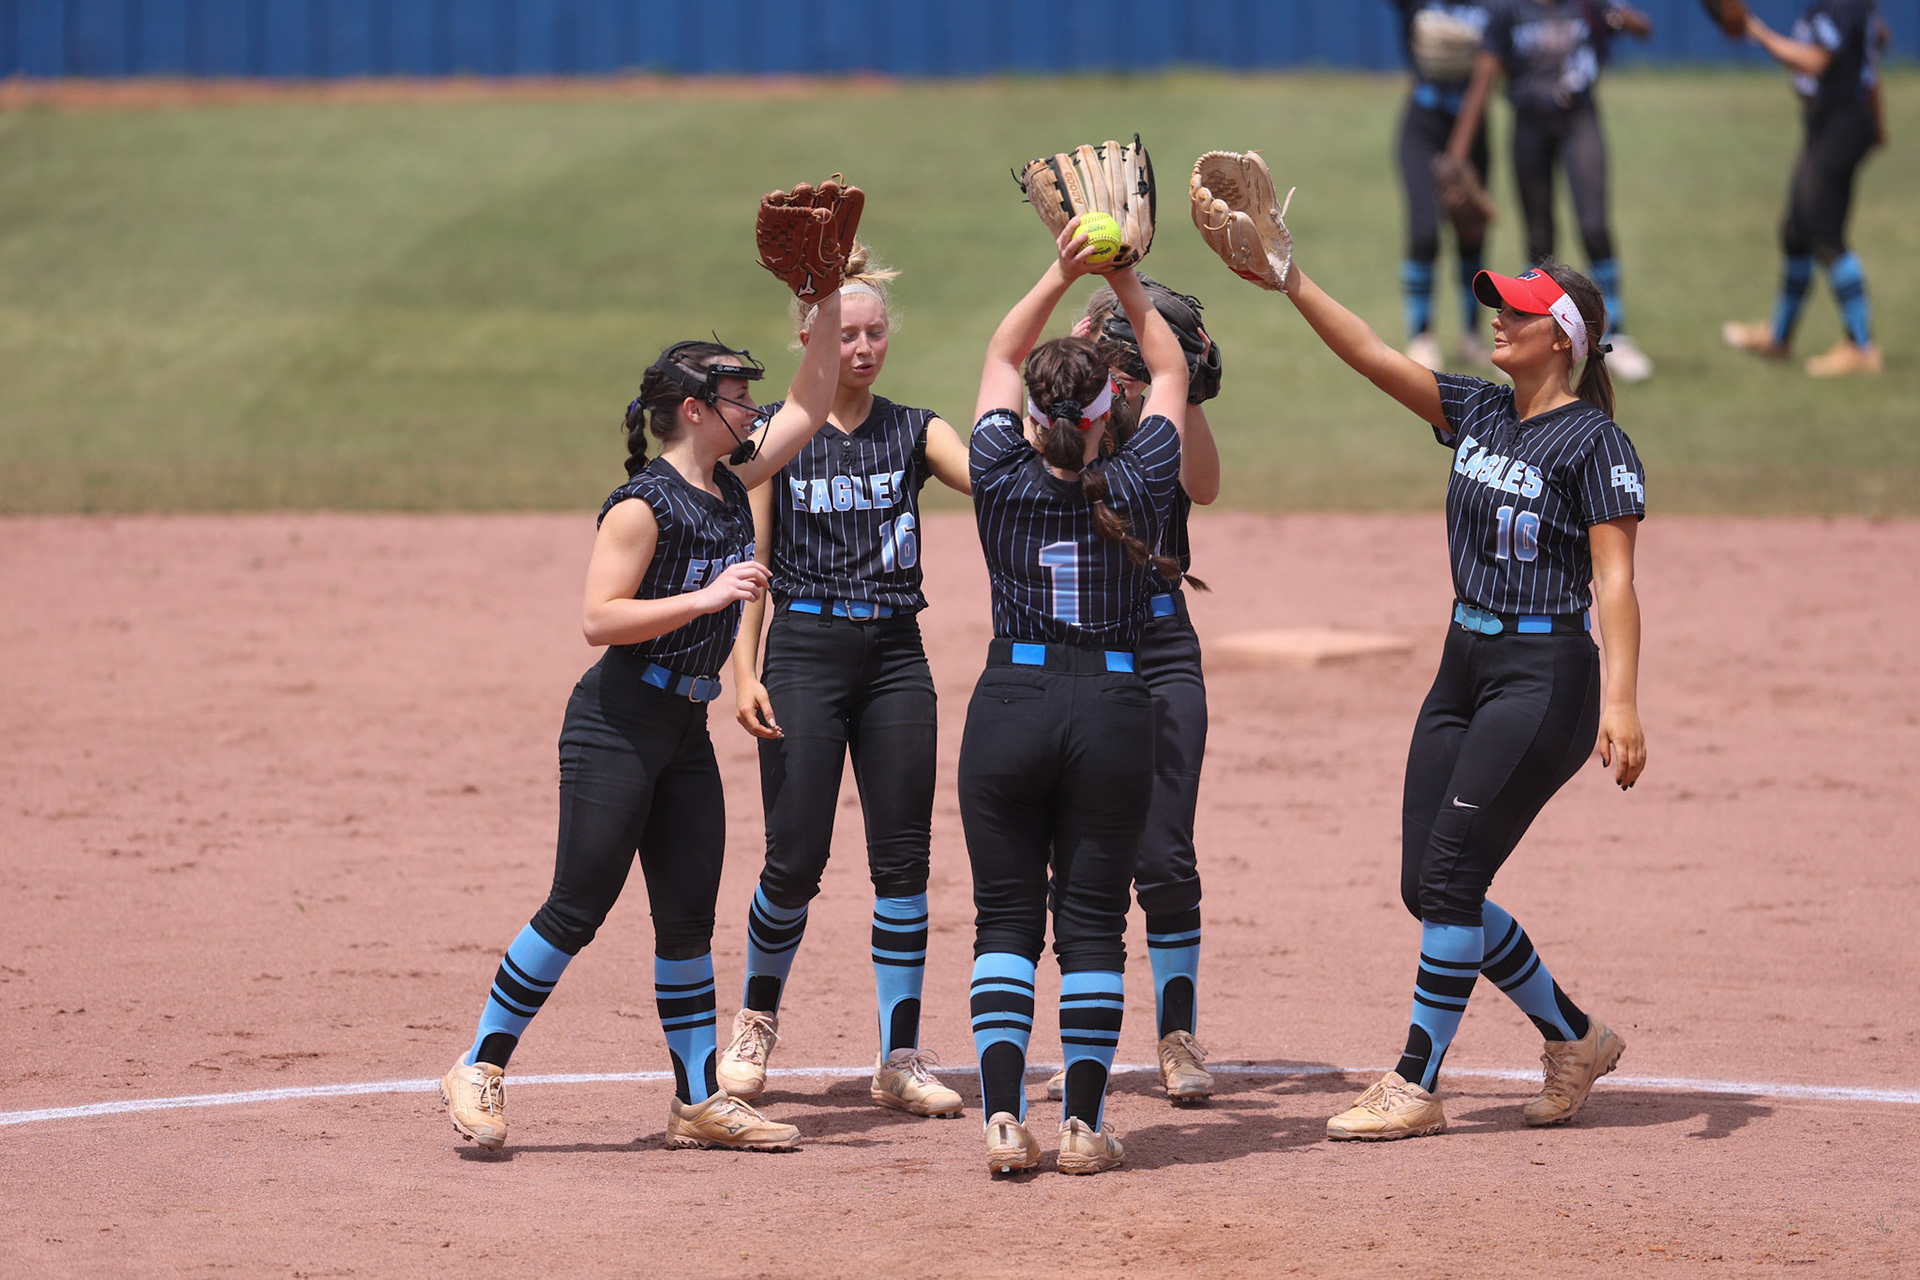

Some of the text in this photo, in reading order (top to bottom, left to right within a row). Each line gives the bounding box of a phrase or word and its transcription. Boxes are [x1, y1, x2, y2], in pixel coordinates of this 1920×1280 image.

[1065, 172, 1084, 204] A2000
[789, 470, 905, 514] EAGLES
[1454, 435, 1544, 499] EAGLES
[878, 511, 917, 573] 16
[1495, 505, 1541, 562] 10
[1039, 541, 1080, 626] 1
